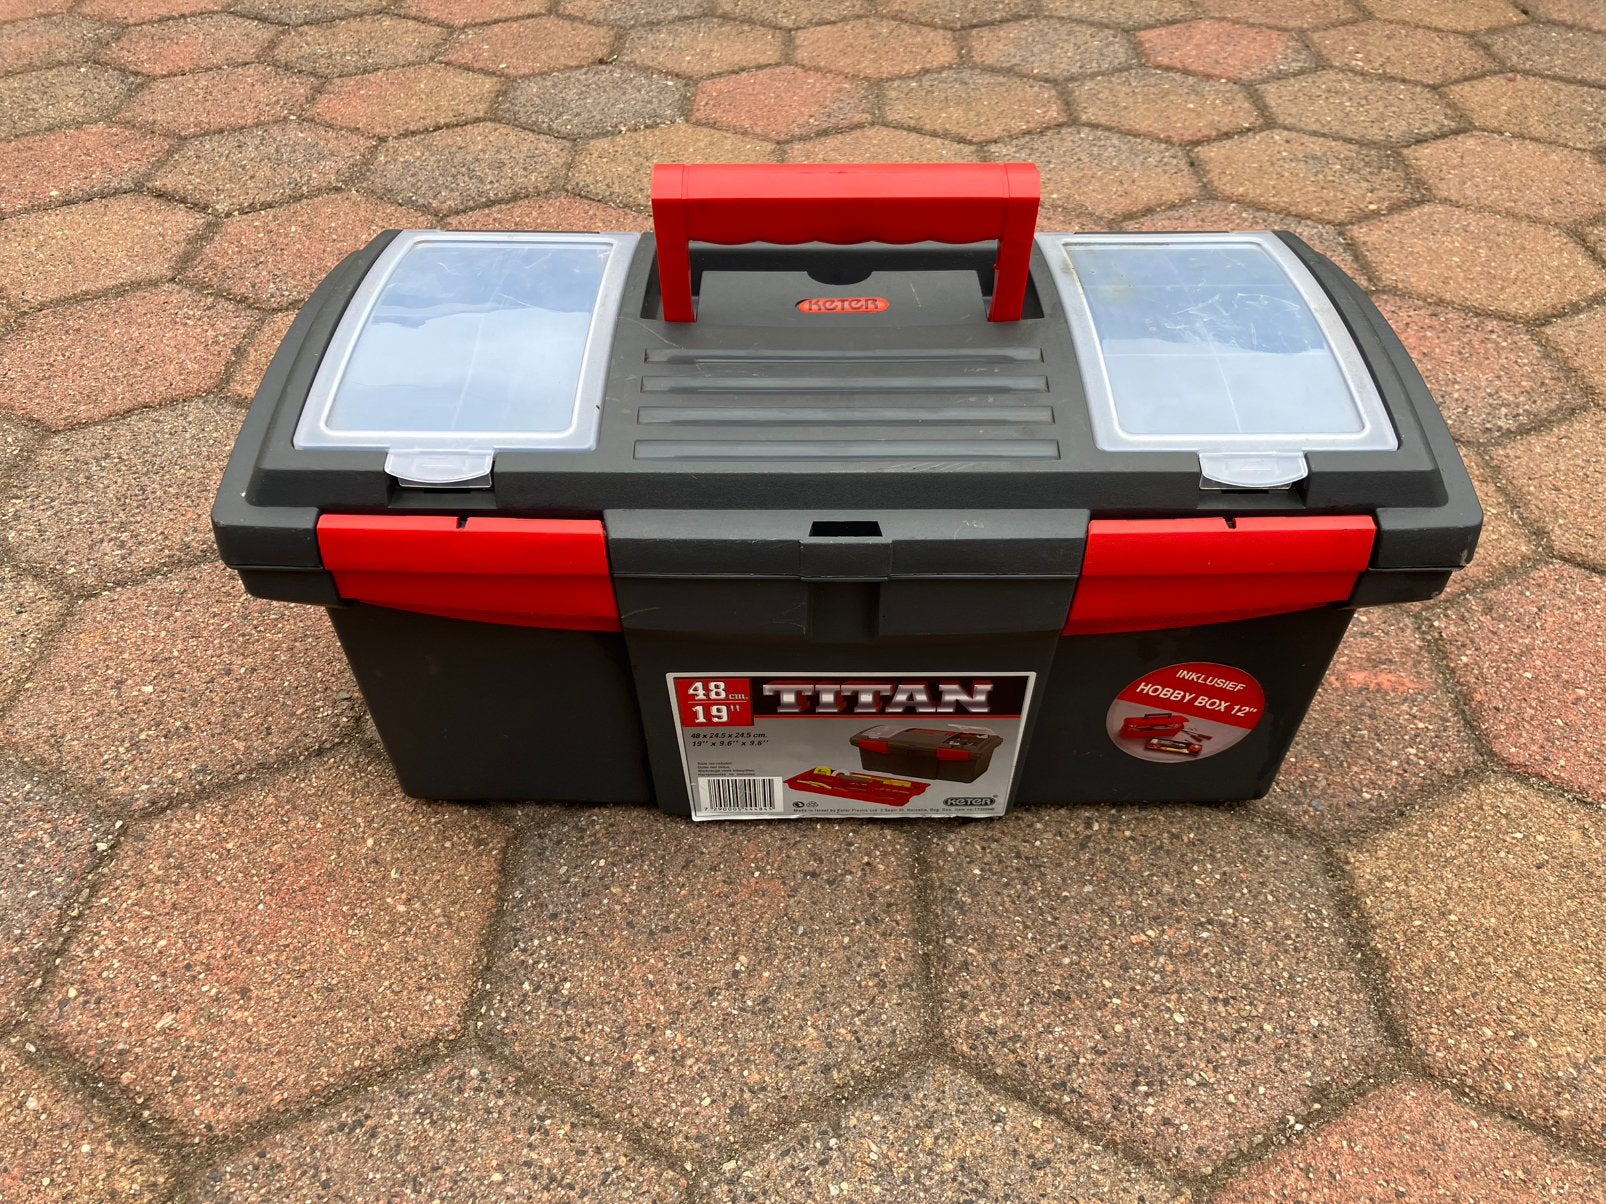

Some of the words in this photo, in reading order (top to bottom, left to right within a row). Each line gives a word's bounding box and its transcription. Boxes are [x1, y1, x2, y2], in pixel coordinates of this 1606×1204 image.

[808, 298, 879, 311] KETER
[687, 681, 727, 700] 48
[1176, 669, 1247, 692] INKLUSIEF
[763, 682, 993, 713] TITAN
[1136, 682, 1195, 703] HOBBY
[1194, 695, 1230, 712] BOX
[947, 798, 992, 806] KETER
